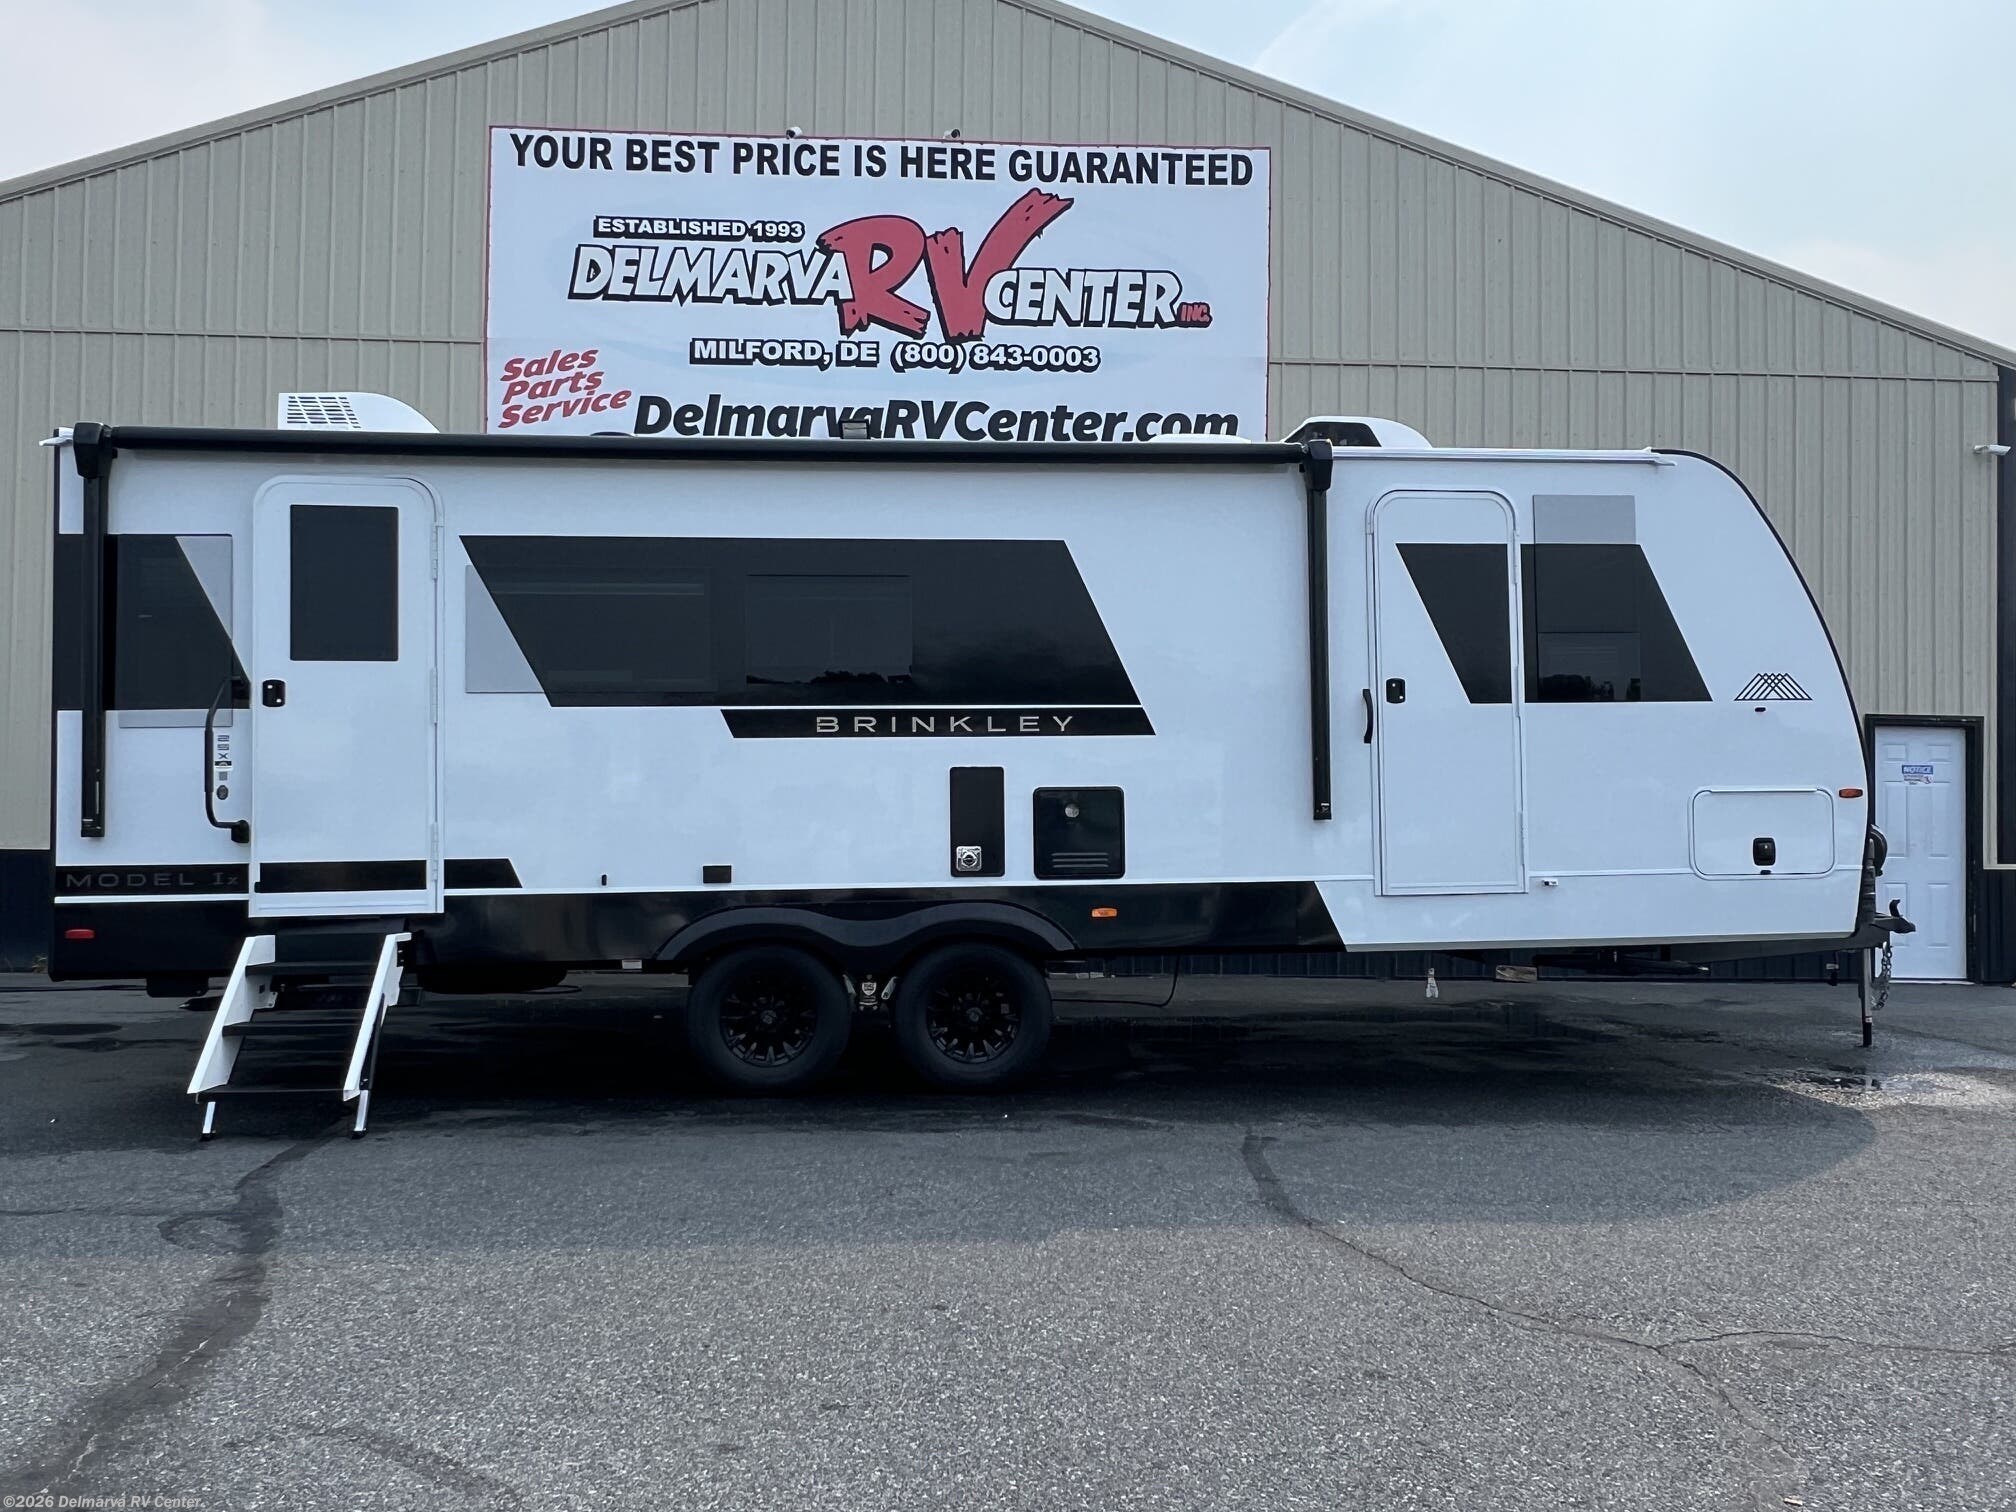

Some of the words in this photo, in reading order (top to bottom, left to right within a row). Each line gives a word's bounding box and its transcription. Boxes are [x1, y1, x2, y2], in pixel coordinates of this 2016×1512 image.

[510, 133, 613, 171] YOUR
[626, 138, 720, 174] BEST
[733, 142, 840, 177] PRICE
[853, 145, 887, 178] IS
[900, 145, 996, 181] HERE
[1008, 149, 1254, 186] GUARANTEED
[596, 217, 747, 238] ESTABLISHED
[751, 221, 805, 239] 1993
[568, 244, 855, 306] DELMARVA
[816, 187, 1074, 343] RV
[982, 267, 1182, 330] CENTER
[500, 349, 600, 382] Sales
[692, 340, 831, 367] MILFORD,
[837, 342, 880, 363] DE
[893, 343, 966, 370] (800)
[972, 345, 1101, 369] 843-0003
[501, 370, 605, 405] Parts
[498, 390, 632, 428] Service
[634, 394, 1239, 441] DelmarvaRVCenter.com
[816, 714, 1074, 734] BRINKLEY
[1903, 766, 1931, 774] NOTICE
[65, 873, 195, 888] MODEL
